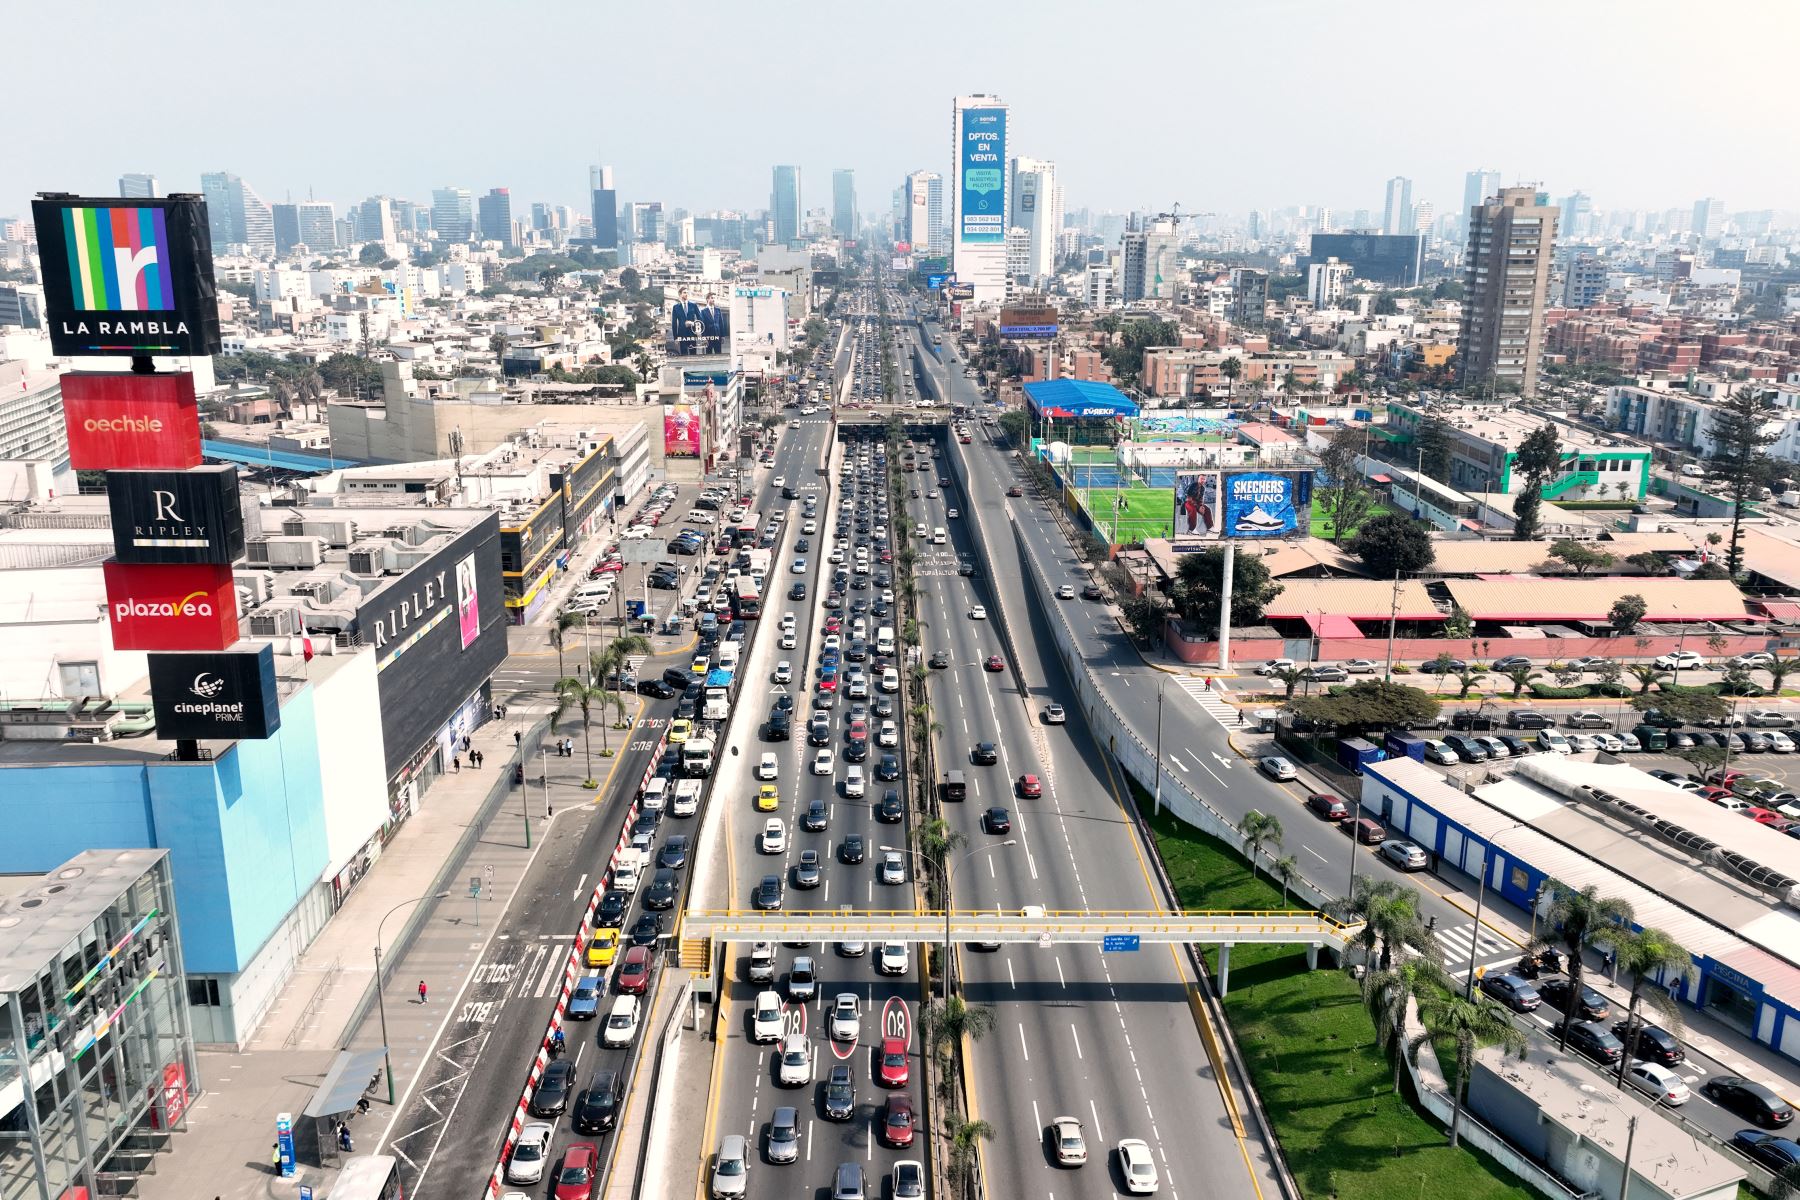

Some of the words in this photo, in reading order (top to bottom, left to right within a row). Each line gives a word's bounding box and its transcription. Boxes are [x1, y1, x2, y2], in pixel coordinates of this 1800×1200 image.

[968, 132, 1000, 141] DPTOS.
[978, 143, 990, 151] EN
[970, 153, 998, 162] VENTA
[63, 322, 90, 335] LA
[99, 322, 190, 335] RAMBLA
[84, 415, 163, 432] oechsle
[1233, 480, 1284, 494] SKECHERS
[1255, 494, 1284, 503] UNO
[153, 490, 185, 522] R
[135, 526, 206, 536] RIPLEY
[374, 571, 446, 649] RIPLEY
[174, 702, 243, 715] cineplanet
[215, 713, 243, 722] PRIME
[630, 741, 653, 751] BUS
[1714, 963, 1750, 989] PISCINA
[457, 1002, 494, 1022] BUS
